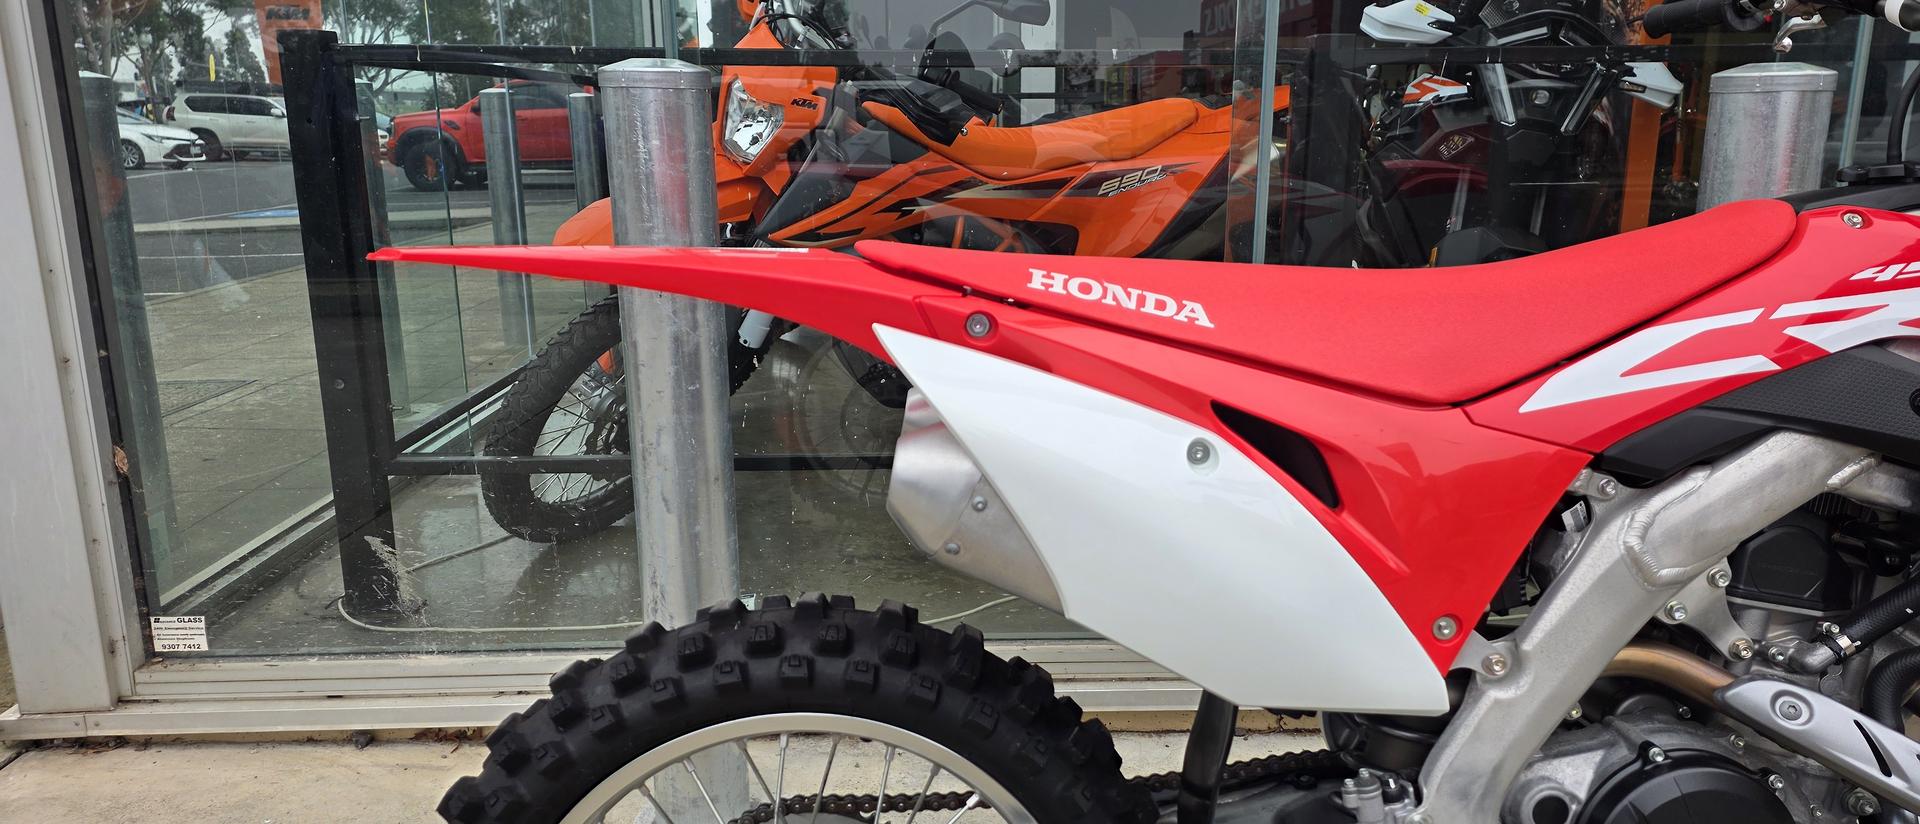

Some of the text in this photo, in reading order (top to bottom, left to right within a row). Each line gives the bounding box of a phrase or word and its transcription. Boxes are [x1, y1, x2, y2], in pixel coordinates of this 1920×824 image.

[791, 97, 818, 110] KTM
[1097, 165, 1162, 196] 690
[1027, 268, 1215, 328] HONDA
